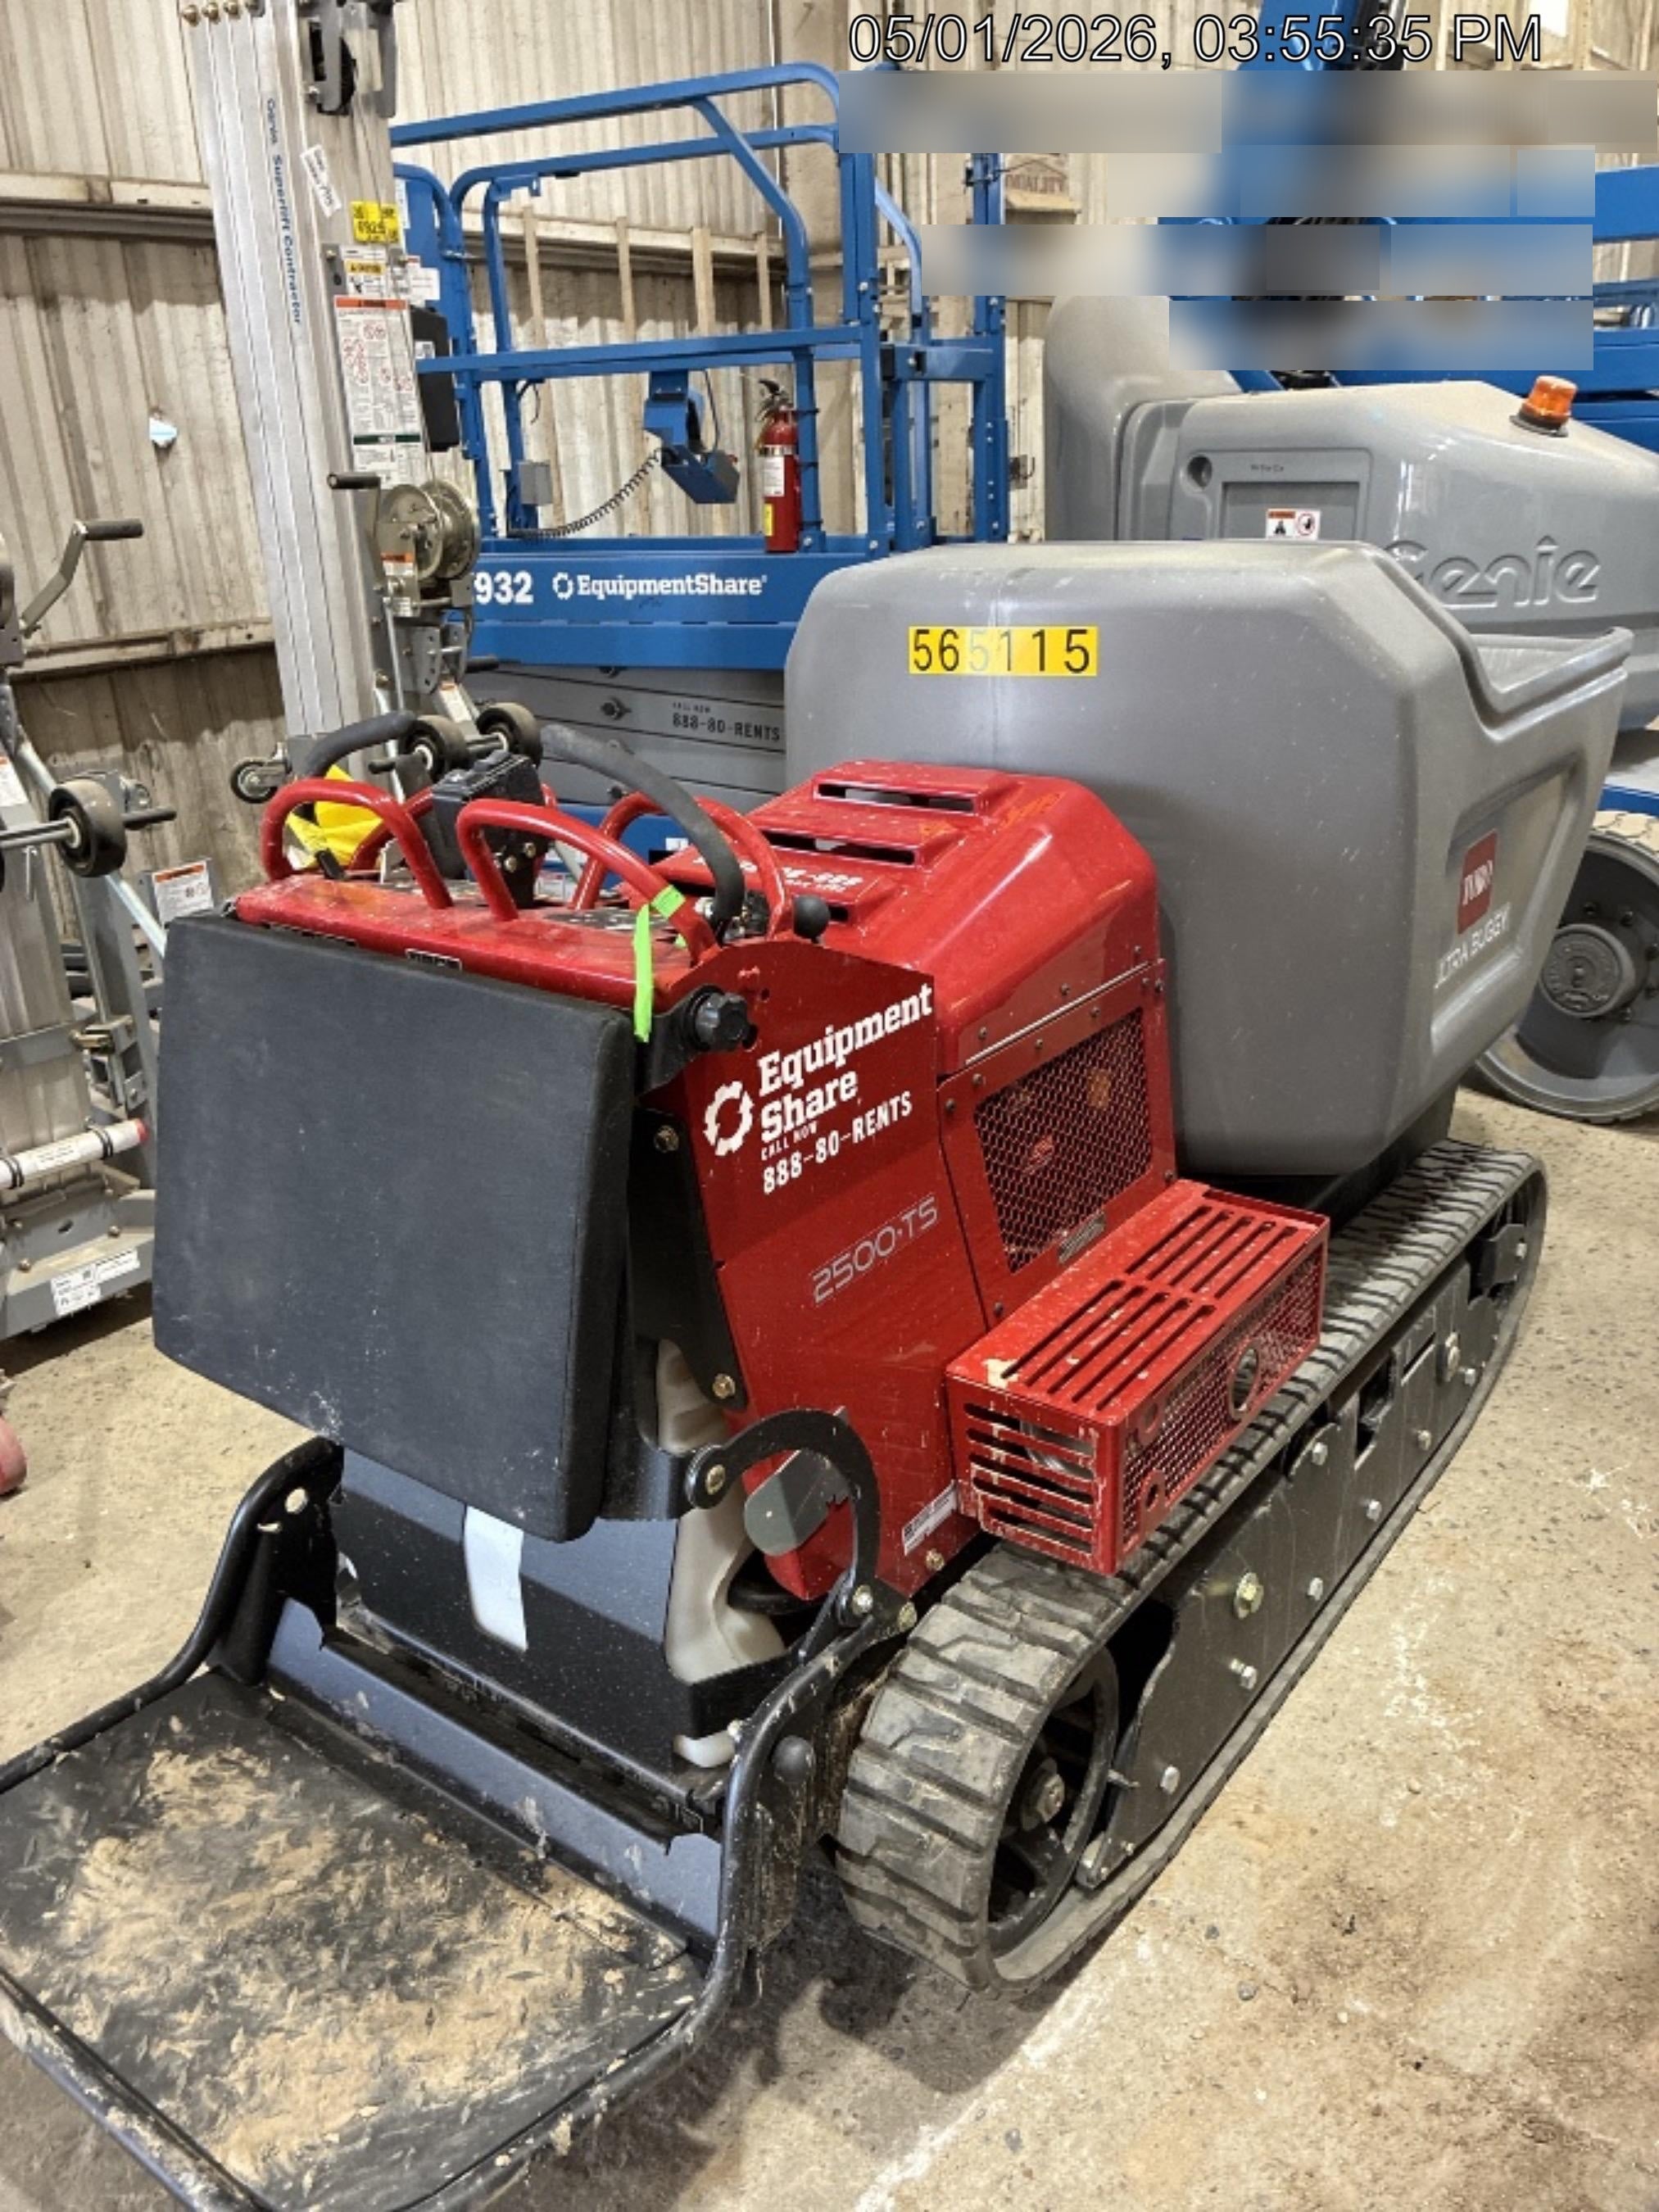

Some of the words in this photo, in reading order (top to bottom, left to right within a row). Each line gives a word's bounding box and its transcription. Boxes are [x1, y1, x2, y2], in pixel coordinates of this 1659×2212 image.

[273, 153, 291, 231] Superlift
[283, 234, 301, 324] Contractor
[471, 569, 534, 605] 932
[913, 628, 1090, 674] 565115
[672, 712, 781, 742] 888-80-RENTS
[756, 981, 932, 1097] Equipment
[760, 1069, 859, 1144] Share
[760, 1136, 790, 1161] CALL
[793, 1119, 818, 1144] NOW
[763, 1090, 913, 1195] 888-80-RENTS
